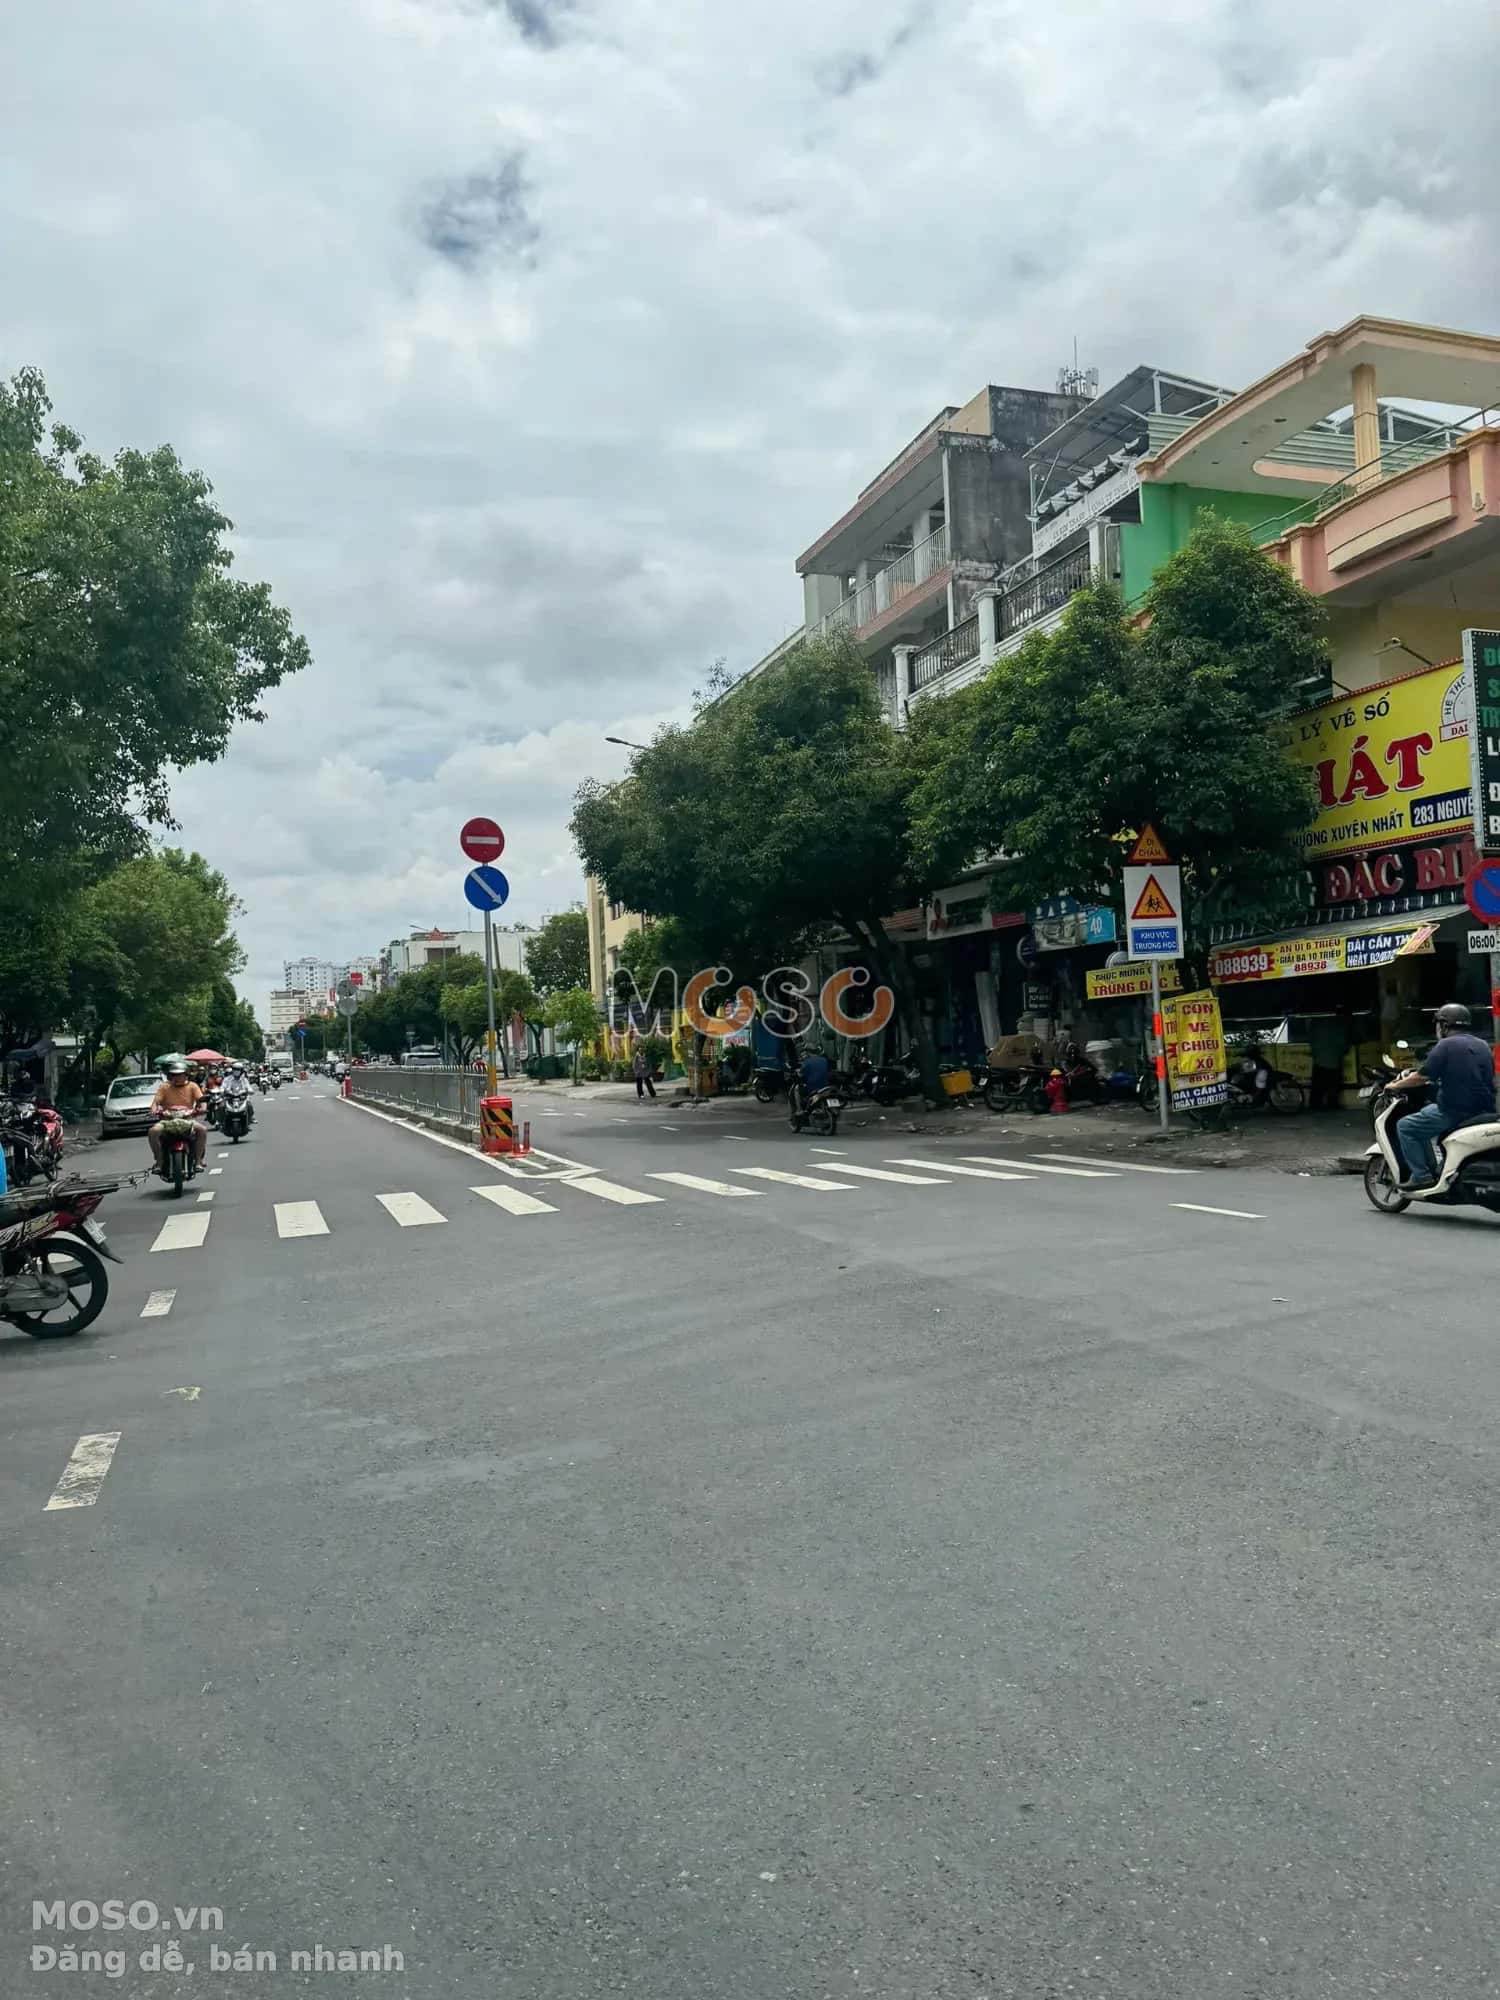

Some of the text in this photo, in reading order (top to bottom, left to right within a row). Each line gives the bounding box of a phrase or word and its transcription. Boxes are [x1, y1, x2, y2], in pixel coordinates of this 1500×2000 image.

[1364, 691, 1391, 721] SỐ
[1331, 819, 1369, 842] XUYÊN
[1372, 808, 1404, 833] NHẤT
[1414, 805, 1434, 826] 283
[1469, 935, 1495, 949] 06:00
[1215, 952, 1269, 978] 088939
